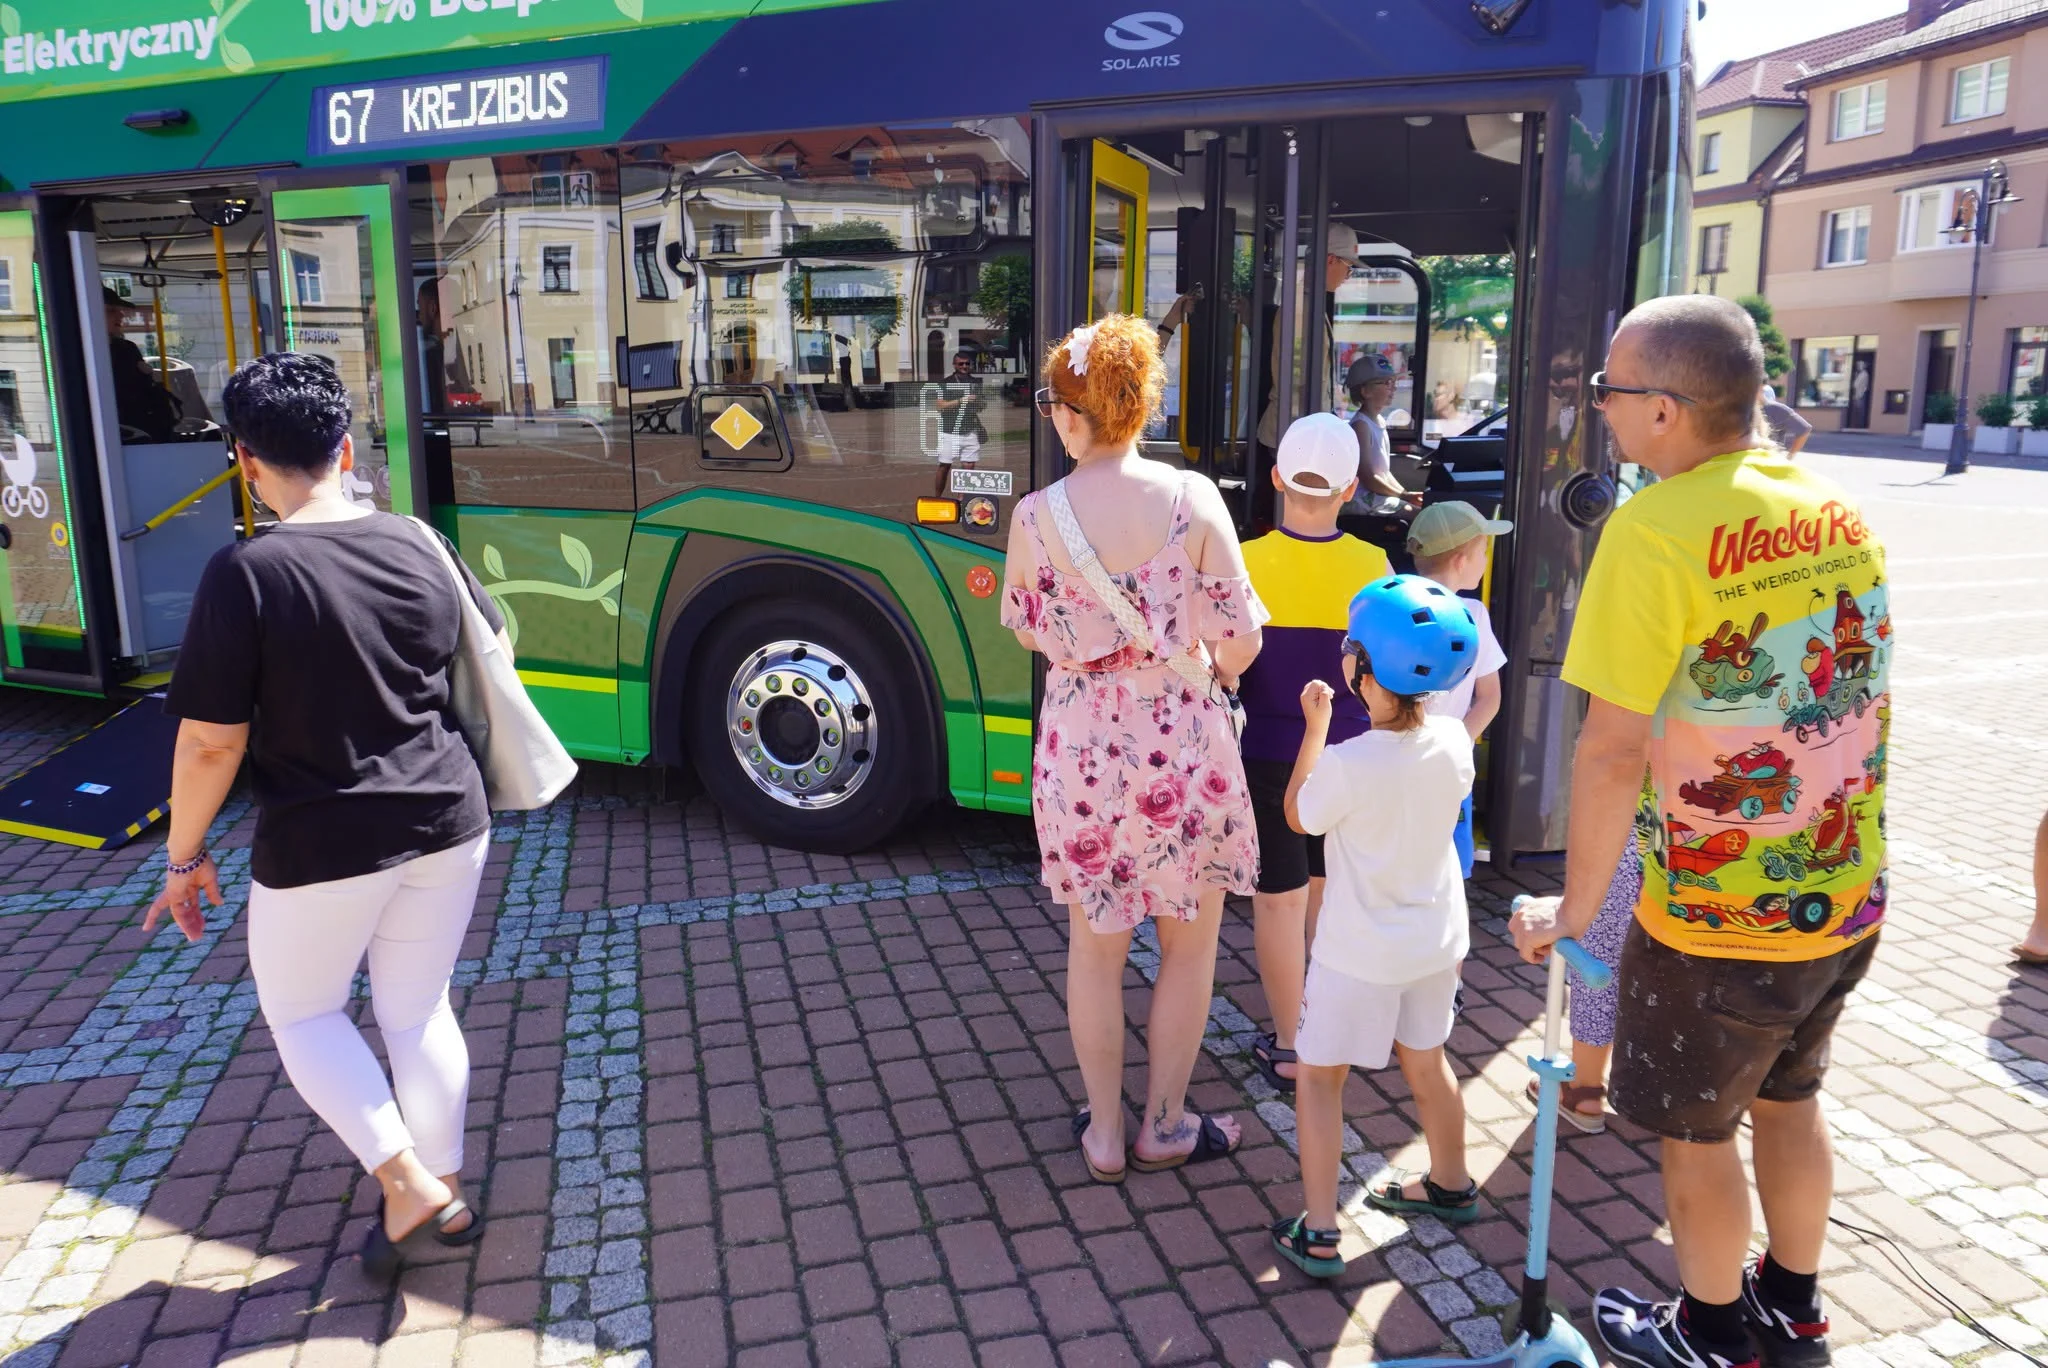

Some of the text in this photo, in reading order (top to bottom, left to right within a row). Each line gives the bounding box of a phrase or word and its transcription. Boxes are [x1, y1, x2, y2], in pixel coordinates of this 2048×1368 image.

[3, 16, 218, 74] Elektryczny
[1101, 54, 1181, 71] SOLARIS
[329, 71, 569, 146] 67 KREJZIBUS
[919, 382, 971, 457] 67
[1708, 500, 1868, 579] Wacky Ra
[1714, 584, 1747, 602] THE
[1752, 567, 1811, 592] WEIRDO
[1813, 555, 1857, 576] WORLD
